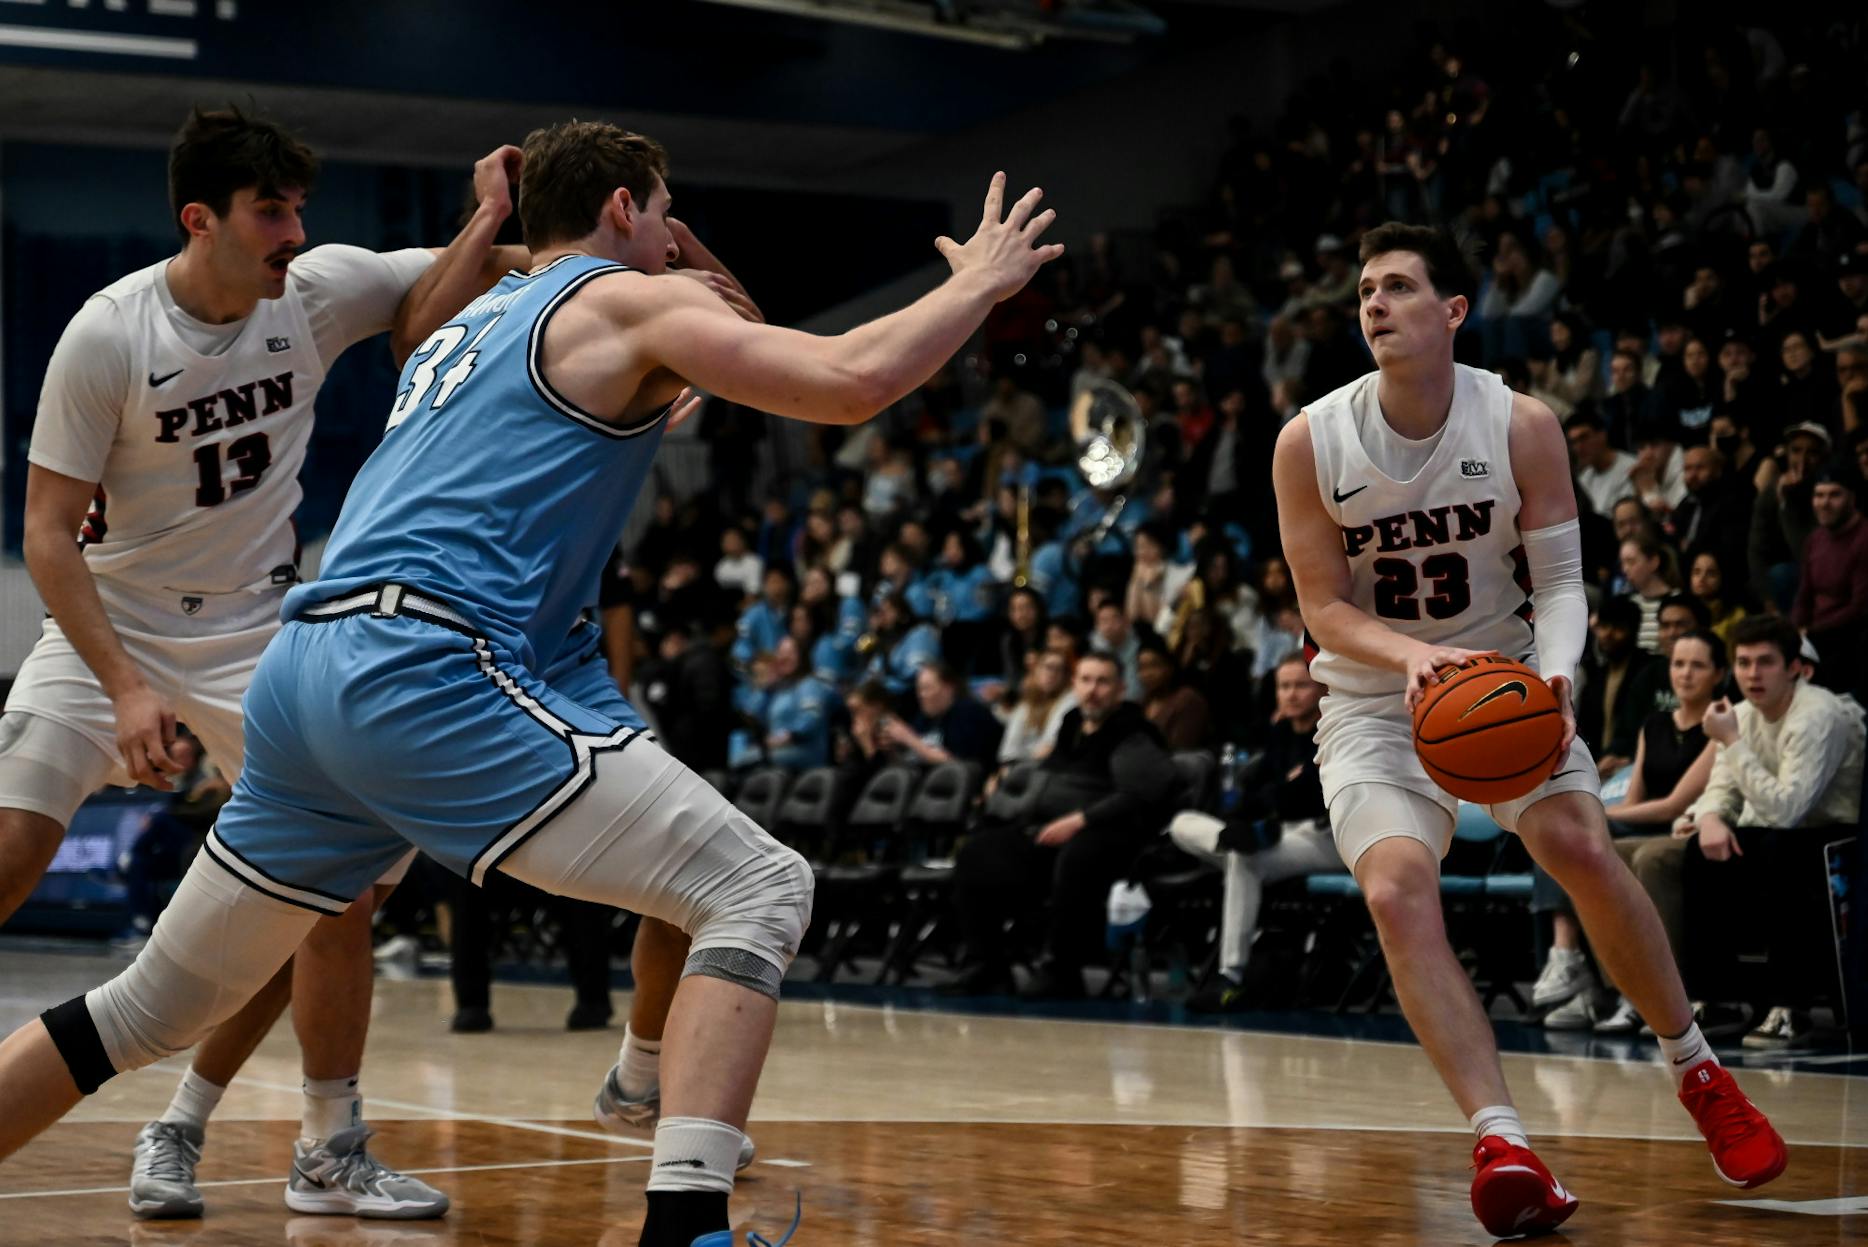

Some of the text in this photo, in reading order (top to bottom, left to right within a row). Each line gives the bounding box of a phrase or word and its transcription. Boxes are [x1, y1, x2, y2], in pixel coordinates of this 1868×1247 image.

[155, 370, 295, 444] PENN
[385, 311, 507, 436] 34
[195, 430, 272, 508] 13
[1341, 499, 1495, 558] PENN
[1373, 551, 1472, 621] 23
